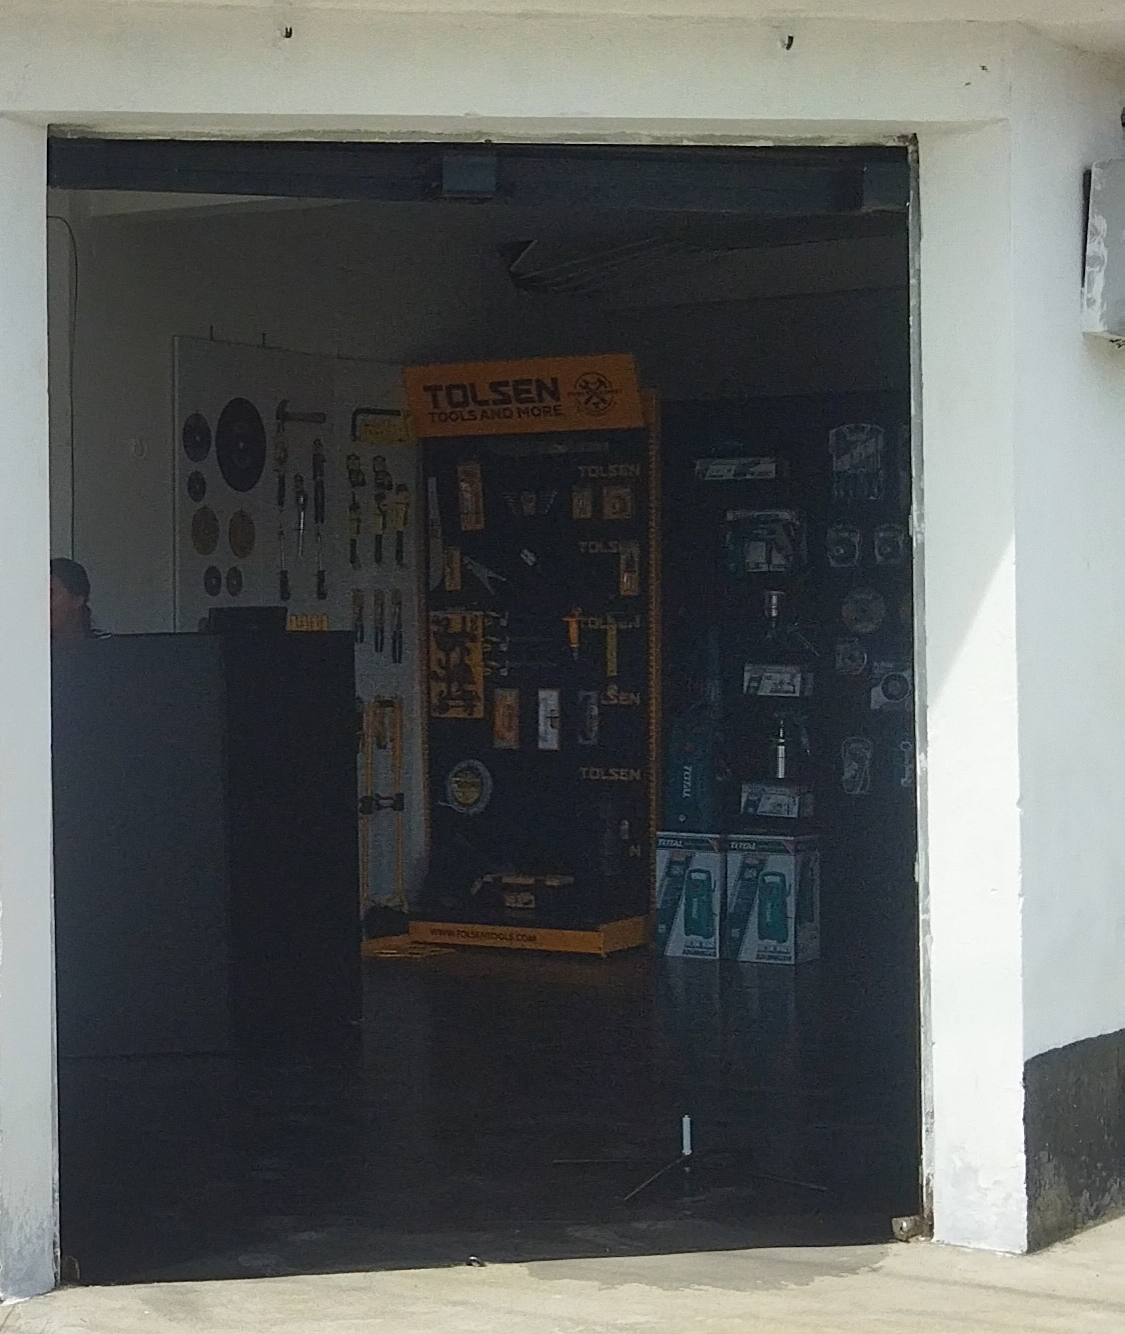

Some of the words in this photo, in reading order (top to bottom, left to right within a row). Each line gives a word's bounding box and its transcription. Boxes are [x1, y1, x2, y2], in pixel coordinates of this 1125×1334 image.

[423, 377, 561, 409] TOLSEN
[428, 410, 477, 423] TOOLS
[480, 407, 514, 421] AND
[516, 404, 565, 419] MORE
[578, 463, 641, 479] TOLSEN
[578, 767, 642, 781] TOLSEN
